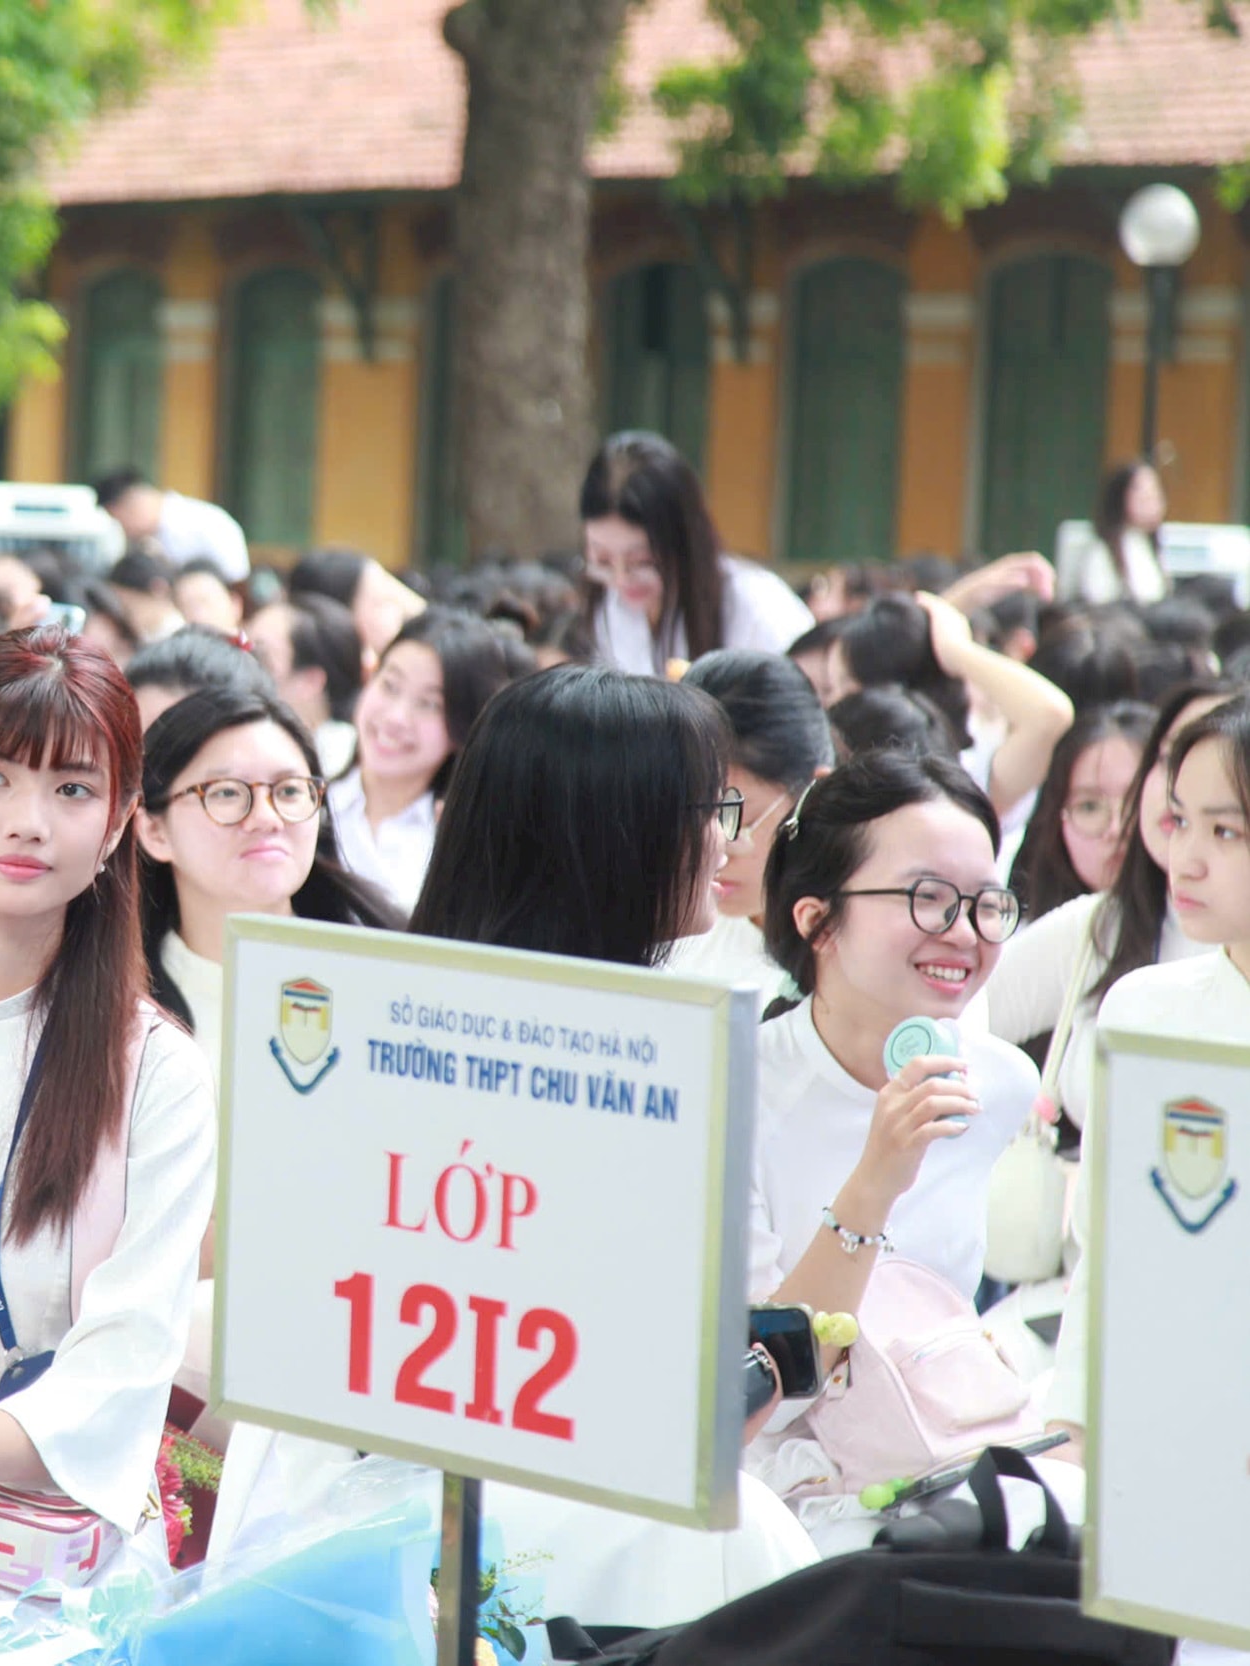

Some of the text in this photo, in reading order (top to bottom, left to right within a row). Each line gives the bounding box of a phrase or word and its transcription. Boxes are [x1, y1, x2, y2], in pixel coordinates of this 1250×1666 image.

[367, 1038, 680, 1123] TRƯỜNG THPT CHU VĂN AN
[390, 994, 658, 1069] SỞ GIÁO DỤC & ĐÀO TẠO HÀ NỘI
[381, 1139, 539, 1251] LỚP
[333, 1270, 581, 1443] 12I2
